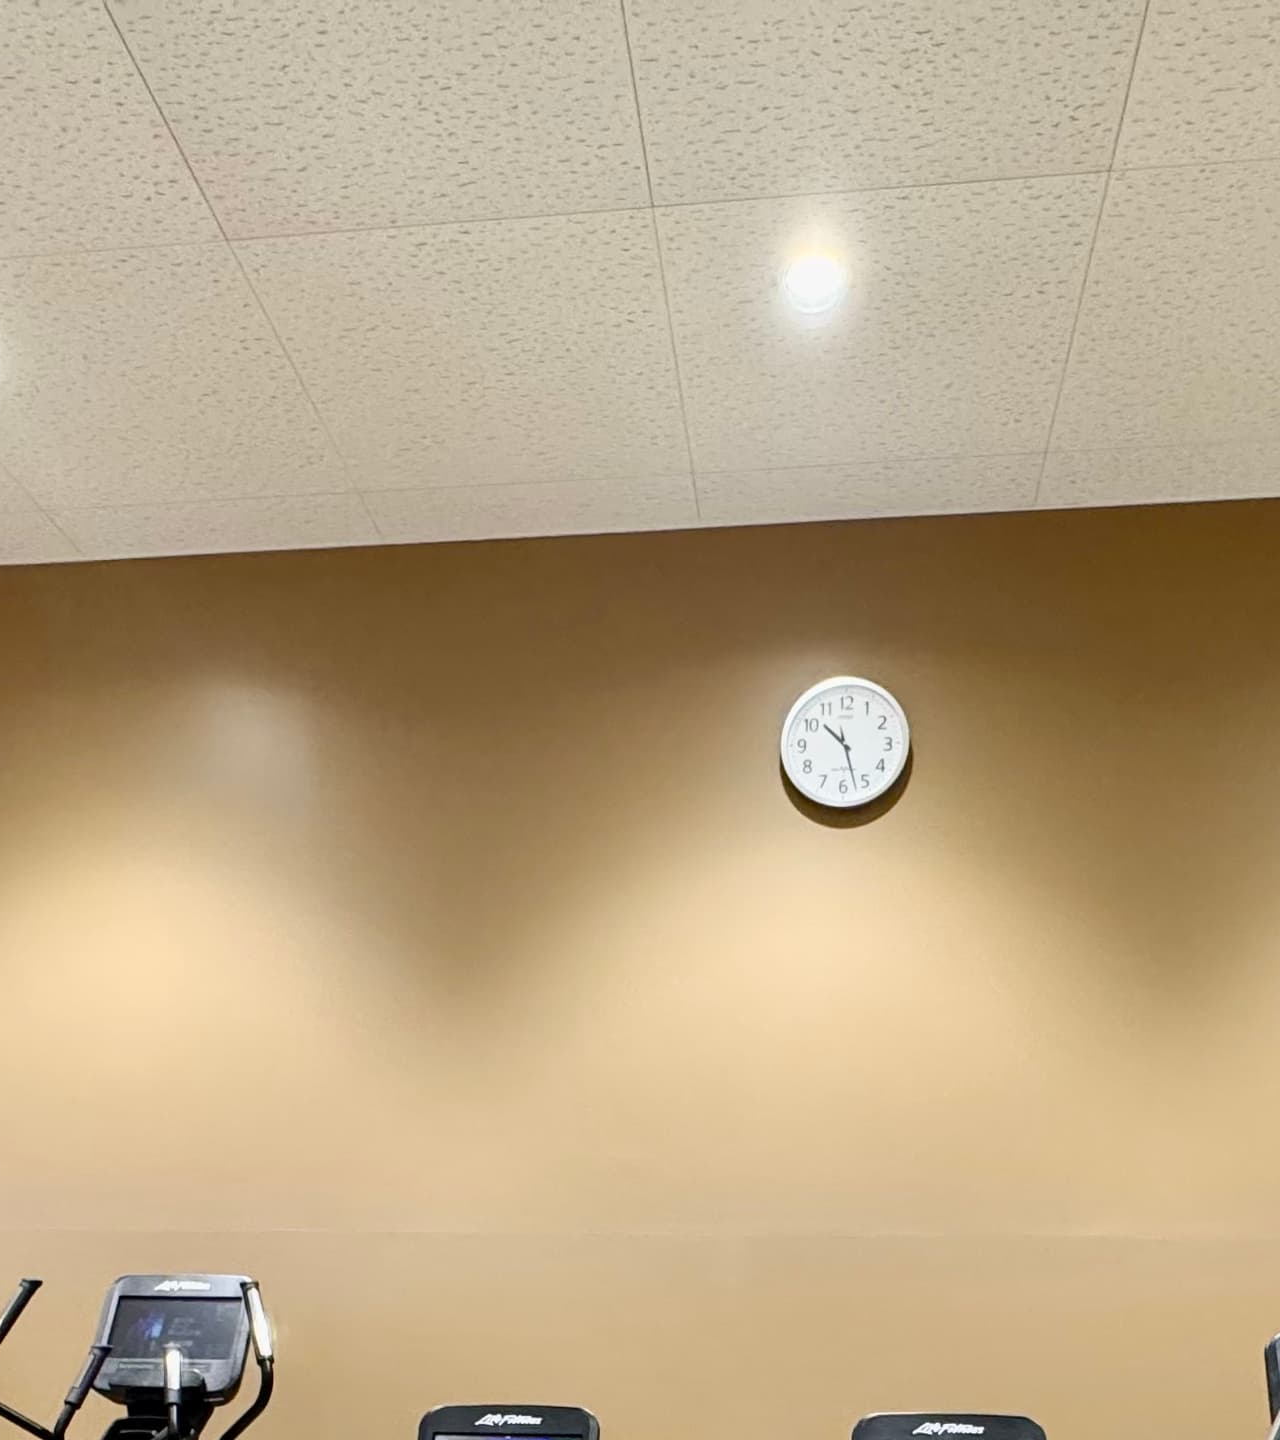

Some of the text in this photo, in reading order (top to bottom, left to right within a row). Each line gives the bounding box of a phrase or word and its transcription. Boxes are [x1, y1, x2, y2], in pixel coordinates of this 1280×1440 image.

[820, 702, 832, 717] 11
[840, 695, 854, 711] 12
[864, 701, 870, 717] 1
[803, 718, 819, 733] 10
[877, 715, 888, 731] 2
[797, 738, 807, 754] 9
[883, 736, 893, 752] 3
[802, 759, 813, 775] 8
[875, 758, 885, 773] 4
[820, 774, 828, 789] 7
[838, 779, 848, 795] 6
[860, 774, 870, 789] 5
